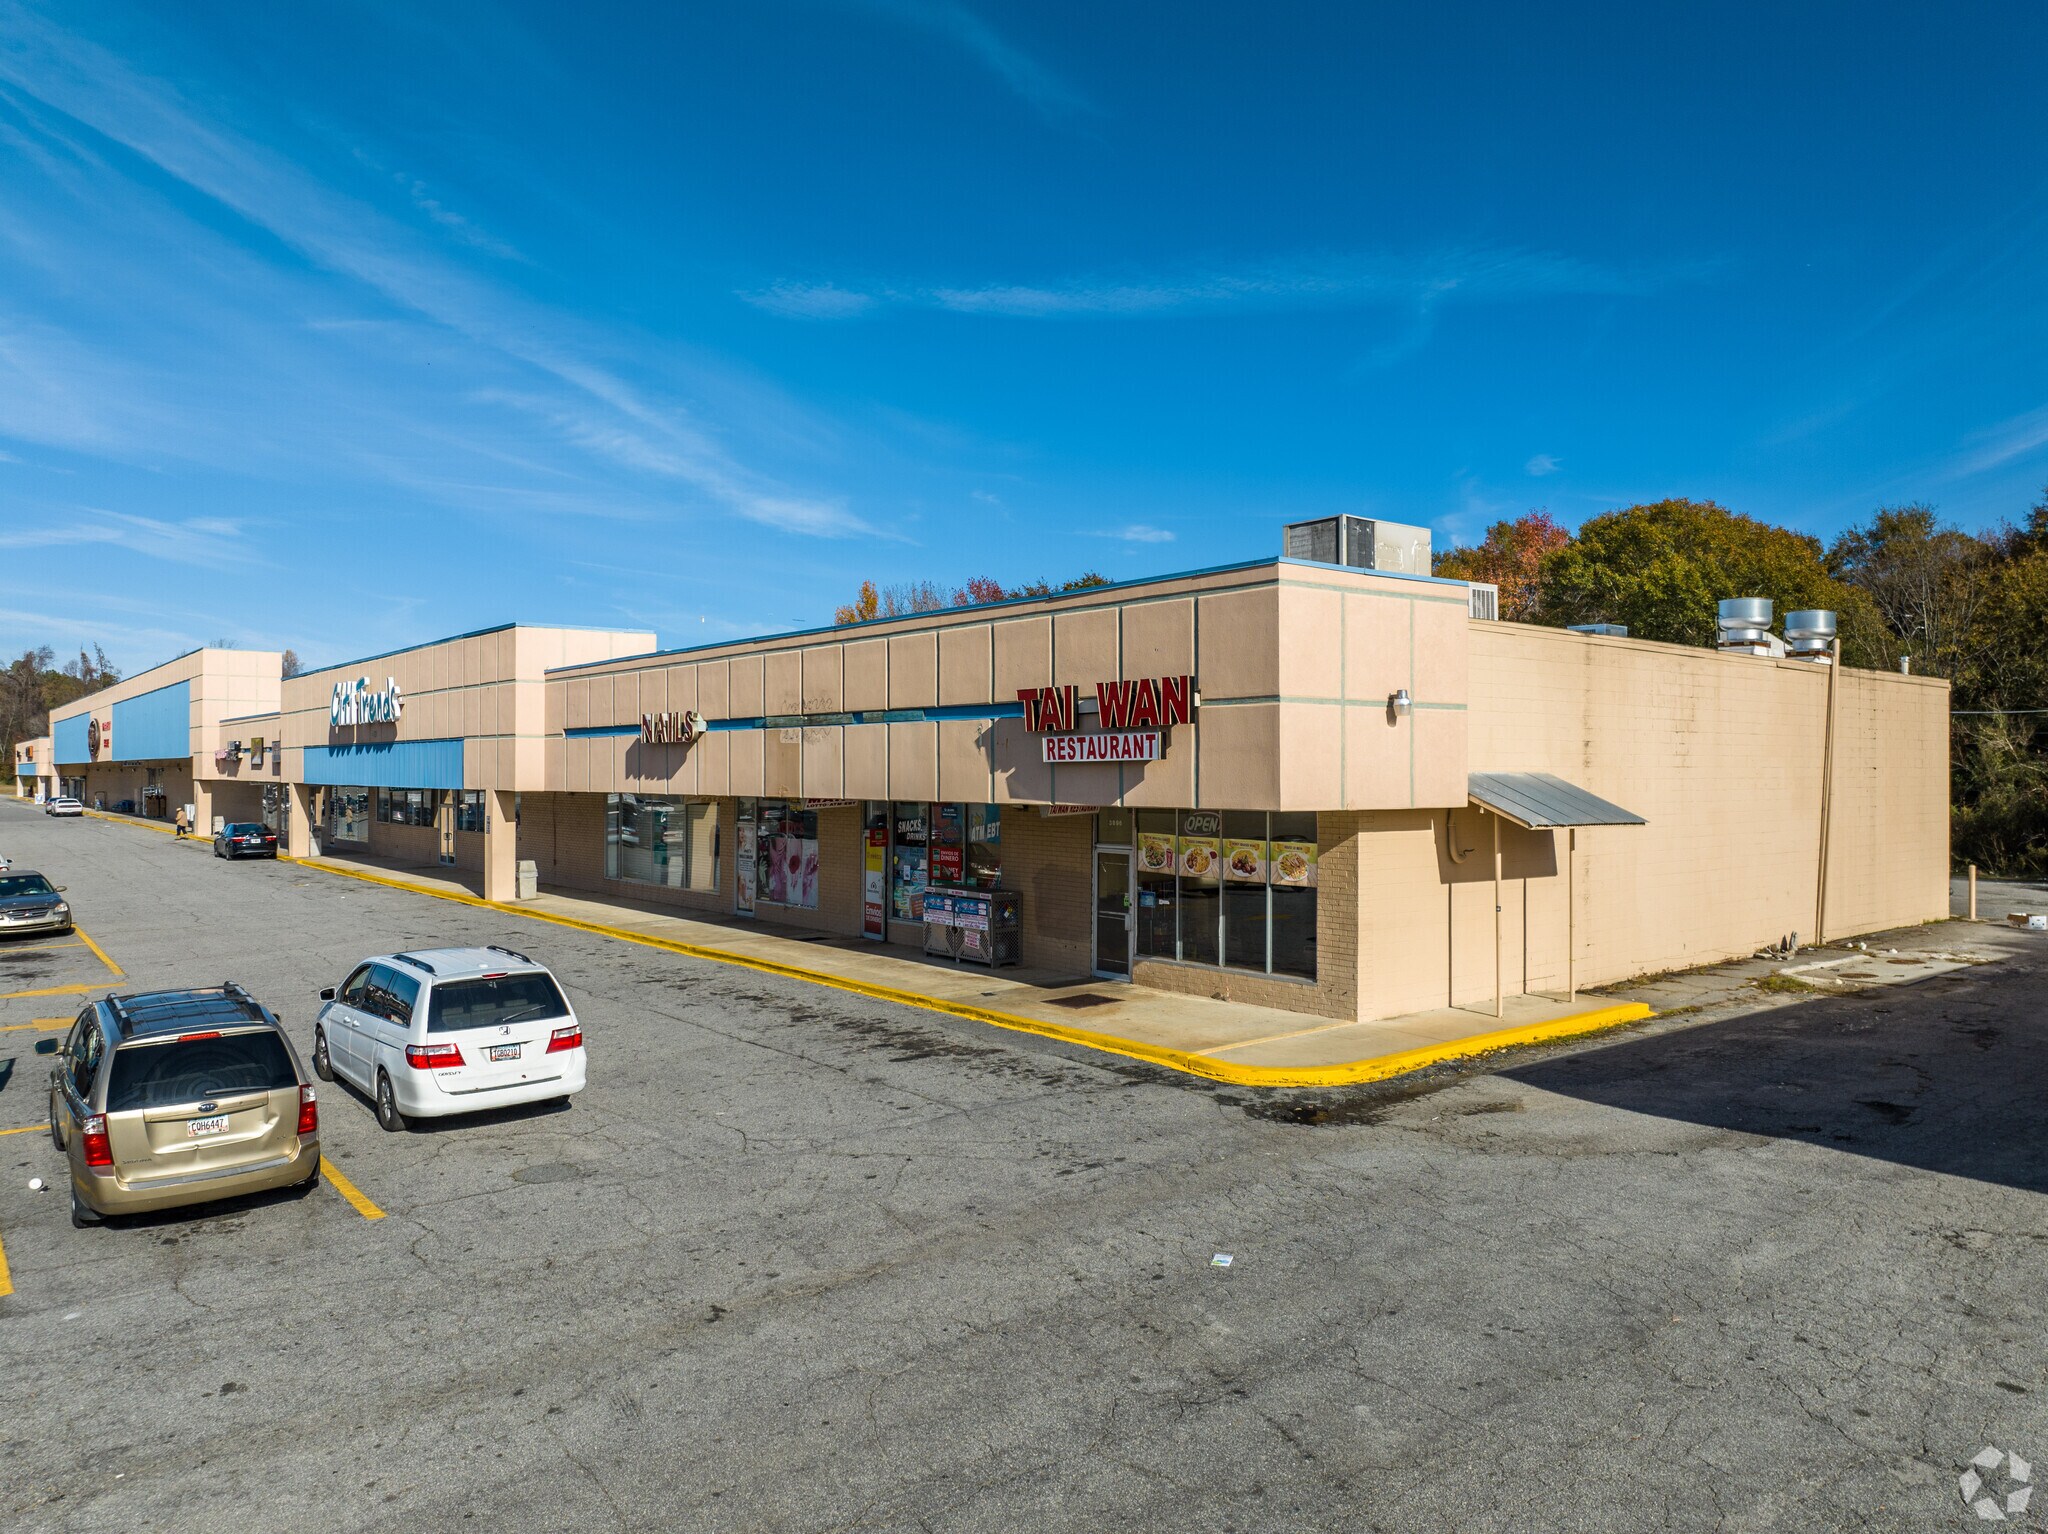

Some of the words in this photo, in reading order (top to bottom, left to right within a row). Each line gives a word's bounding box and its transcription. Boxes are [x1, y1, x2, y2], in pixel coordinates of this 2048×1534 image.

[356, 677, 400, 724] Trends
[1017, 686, 1075, 732] TAI
[1096, 675, 1192, 728] WAN
[641, 711, 695, 743] NAILS
[1046, 733, 1157, 761] RESTAURANT
[906, 833, 927, 841] DRINKS
[971, 824, 985, 842] ATM
[987, 821, 1001, 838] EBT
[1187, 815, 1218, 832] OPEN
